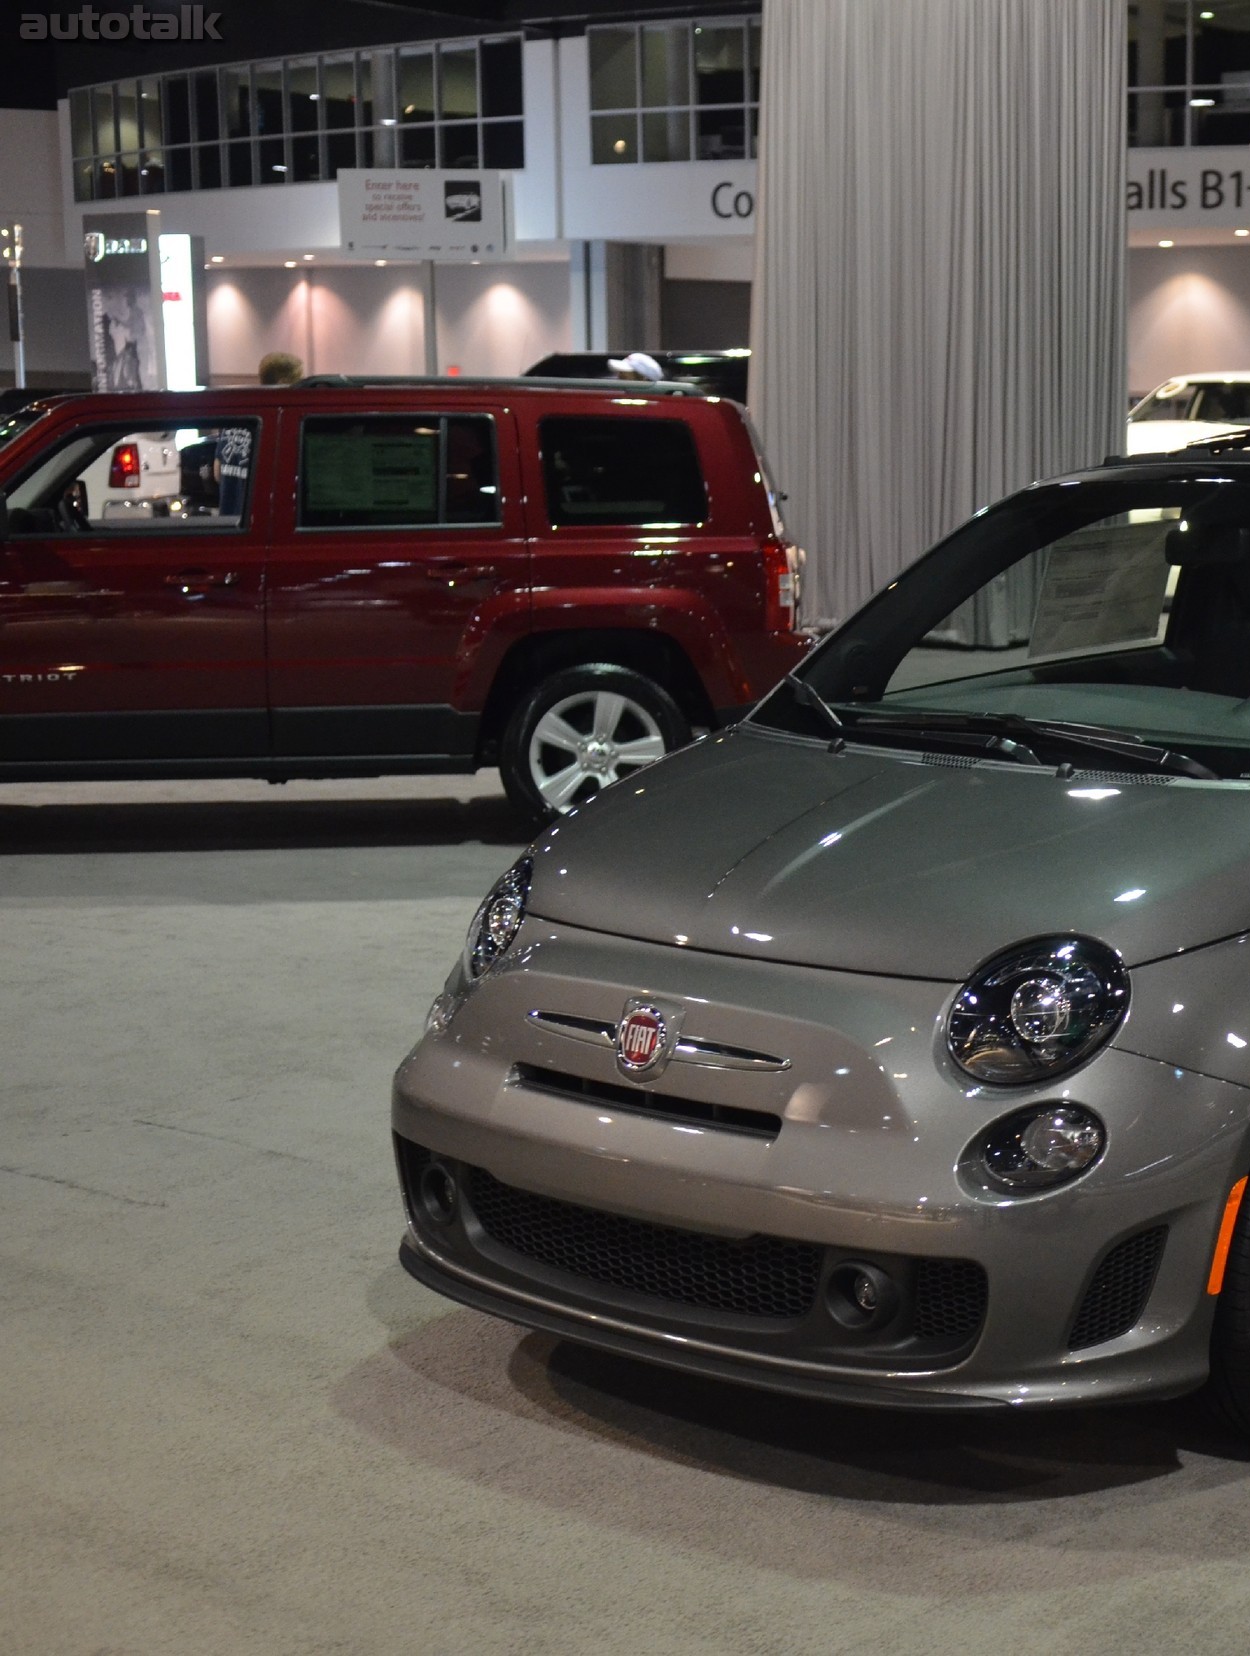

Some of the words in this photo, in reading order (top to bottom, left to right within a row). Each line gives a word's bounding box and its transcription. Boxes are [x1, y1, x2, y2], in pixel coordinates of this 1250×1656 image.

[365, 179, 393, 191] Enter
[396, 179, 420, 191] here
[711, 181, 754, 219] Co
[2, 672, 77, 683] TRIOT
[625, 1023, 656, 1055] FIAT
